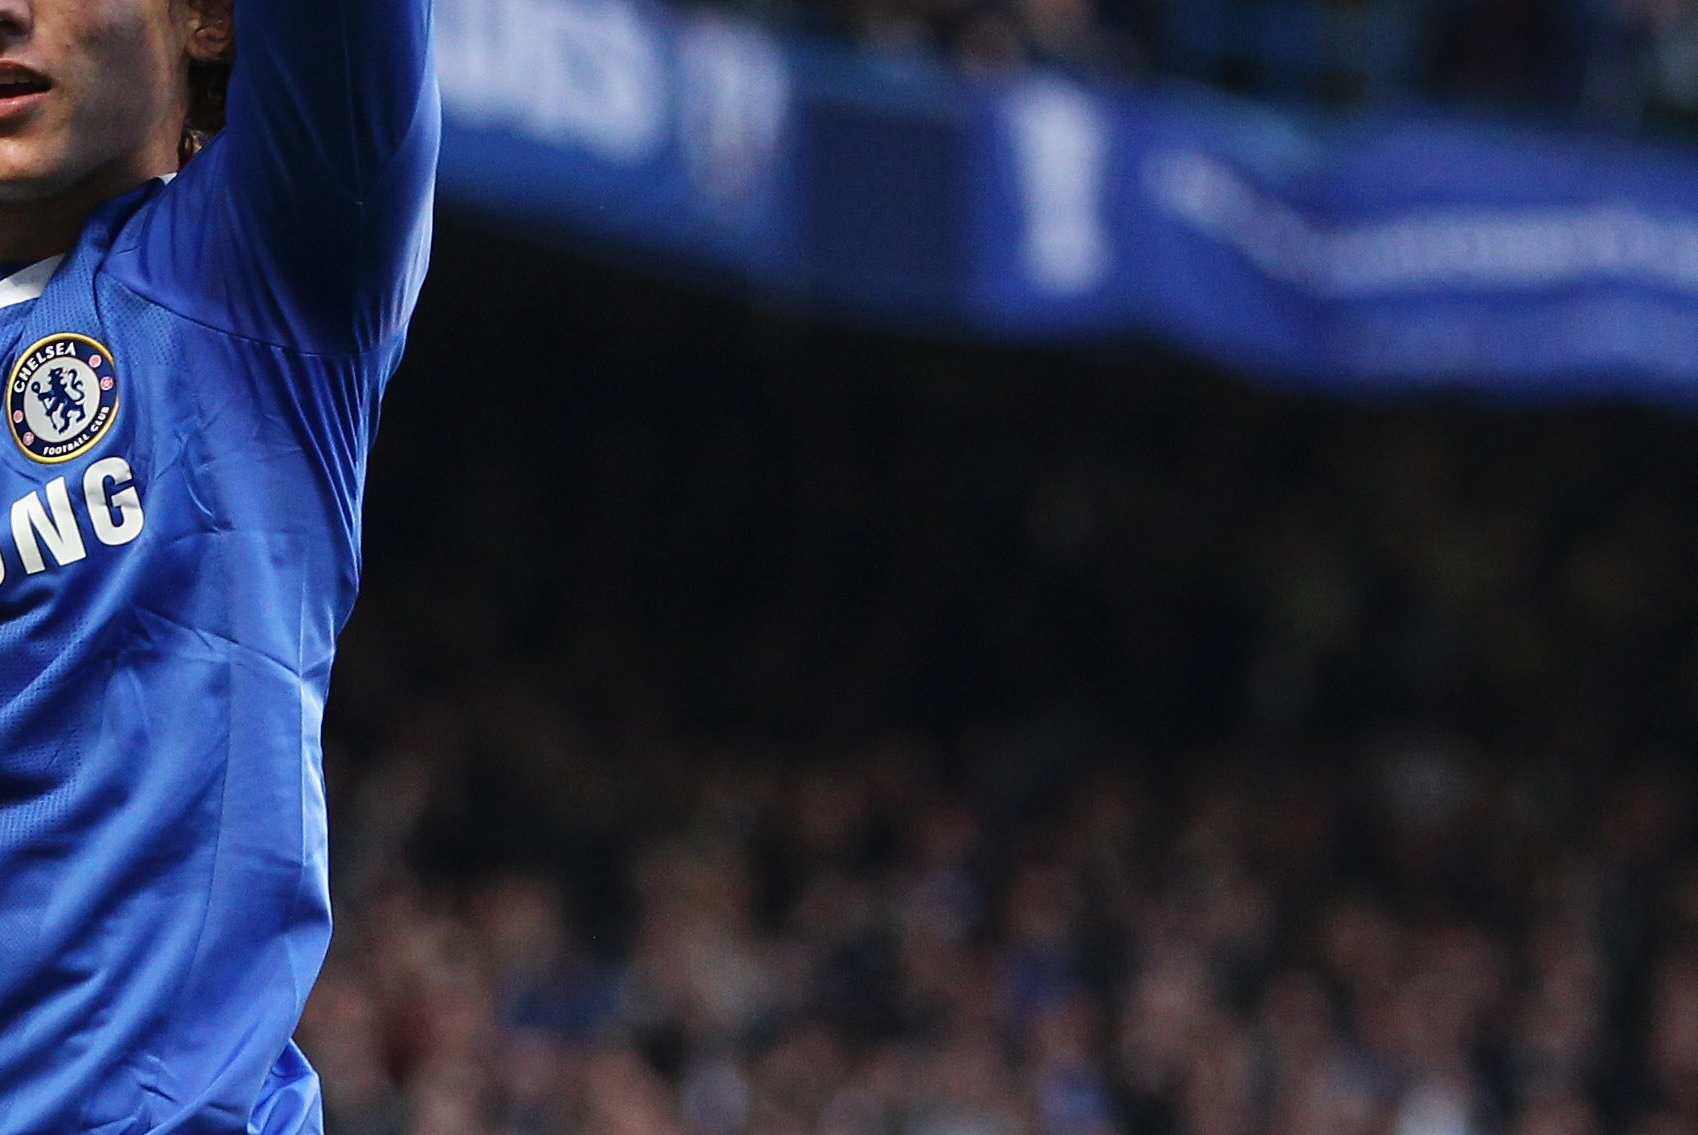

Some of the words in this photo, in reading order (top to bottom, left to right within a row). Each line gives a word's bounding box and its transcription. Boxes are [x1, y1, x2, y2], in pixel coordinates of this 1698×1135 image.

[14, 342, 76, 393] CHELSEA
[43, 434, 90, 455] FOOTBALL
[91, 406, 110, 432] CLUB
